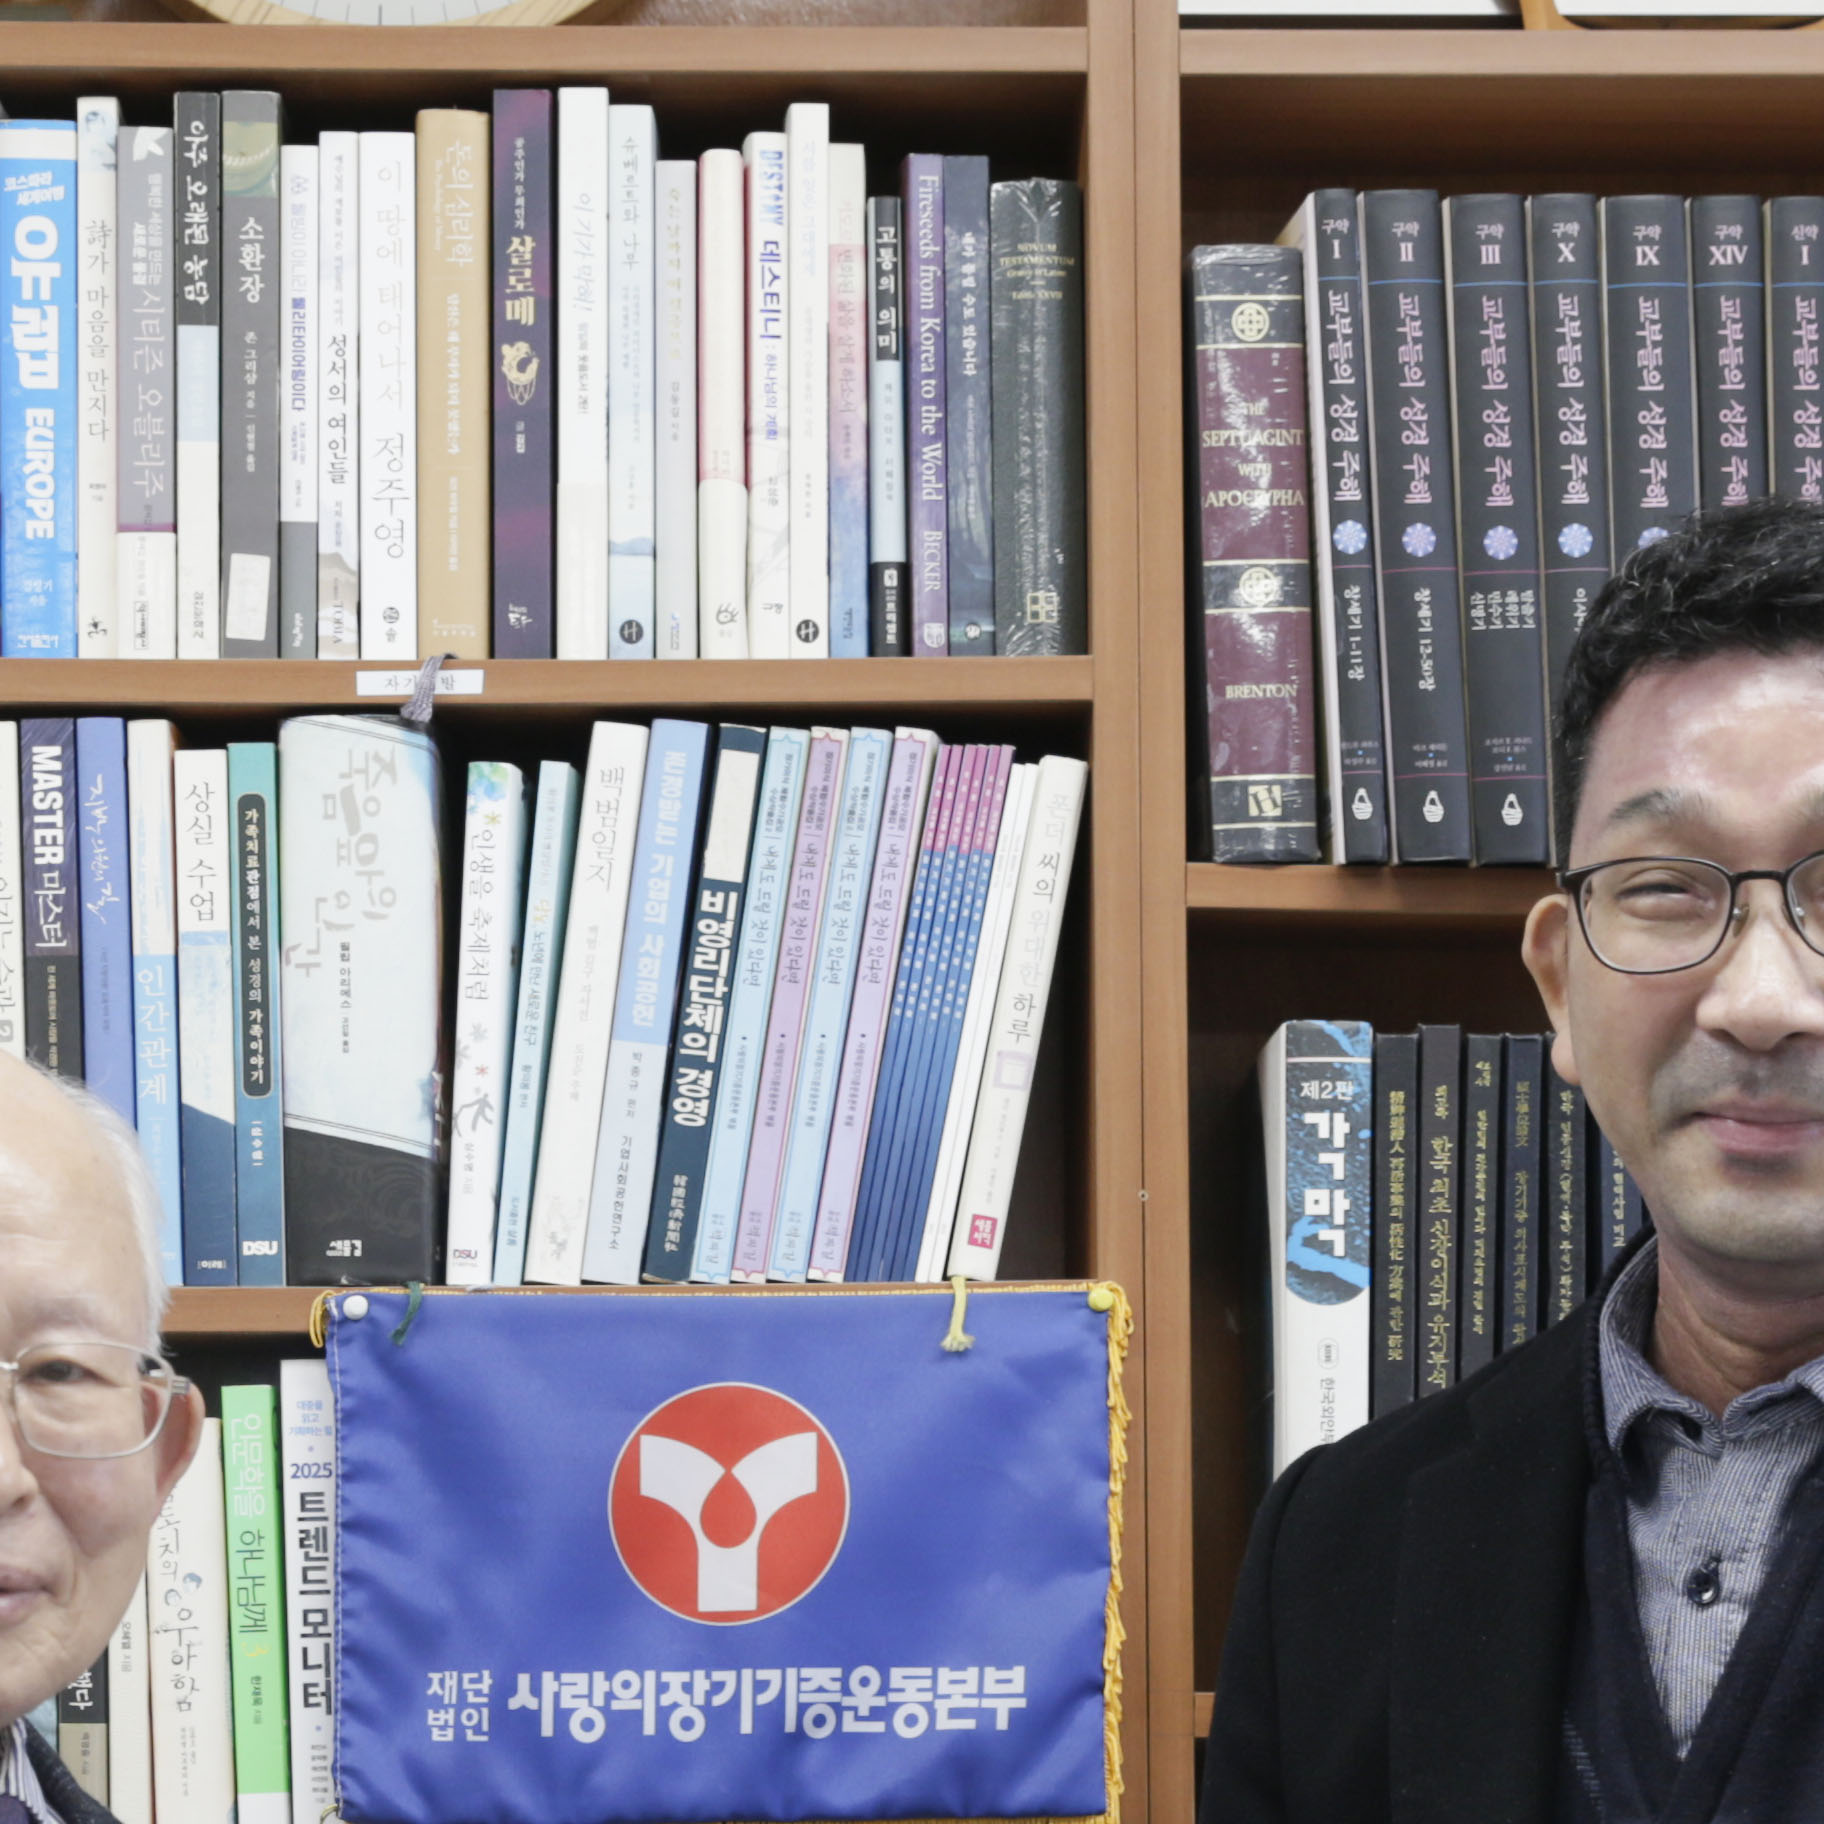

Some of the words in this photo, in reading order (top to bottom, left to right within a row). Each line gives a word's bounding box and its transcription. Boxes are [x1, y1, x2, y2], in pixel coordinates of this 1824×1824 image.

[183, 119, 209, 169] 아주
[184, 179, 209, 246] 오래된
[919, 174, 940, 259] Fireseeds
[1321, 217, 1350, 234] 구약
[184, 257, 210, 305] 농담
[239, 217, 265, 303] 소환장
[876, 225, 897, 294] 고통의
[921, 261, 940, 310] from
[878, 306, 897, 355] 의미
[920, 316, 941, 377] Korea
[1326, 291, 1356, 386] 교부들의
[922, 380, 939, 399] to
[921, 403, 942, 434] the
[1203, 430, 1304, 447] SEPTUAGINT
[1329, 397, 1360, 445] 성경
[25, 408, 55, 541] EUROPE
[921, 441, 943, 502] World
[1238, 463, 1272, 477] WITH
[1330, 454, 1362, 502] 주해
[923, 530, 943, 593] BECKER
[383, 675, 456, 690] 자기발
[1225, 685, 1298, 699] BRENTON
[679, 891, 739, 1064] 비영리단체의
[672, 1066, 710, 1127] 경영
[1300, 1082, 1354, 1099] 제2판
[290, 1463, 332, 1478] 2025
[297, 1492, 330, 1595] 트렌드
[300, 1608, 332, 1715] 모니터
[426, 1669, 493, 1702] 재단
[428, 1706, 491, 1743] 법인
[507, 1664, 1027, 1744] 사랑의장기기증운동본부
